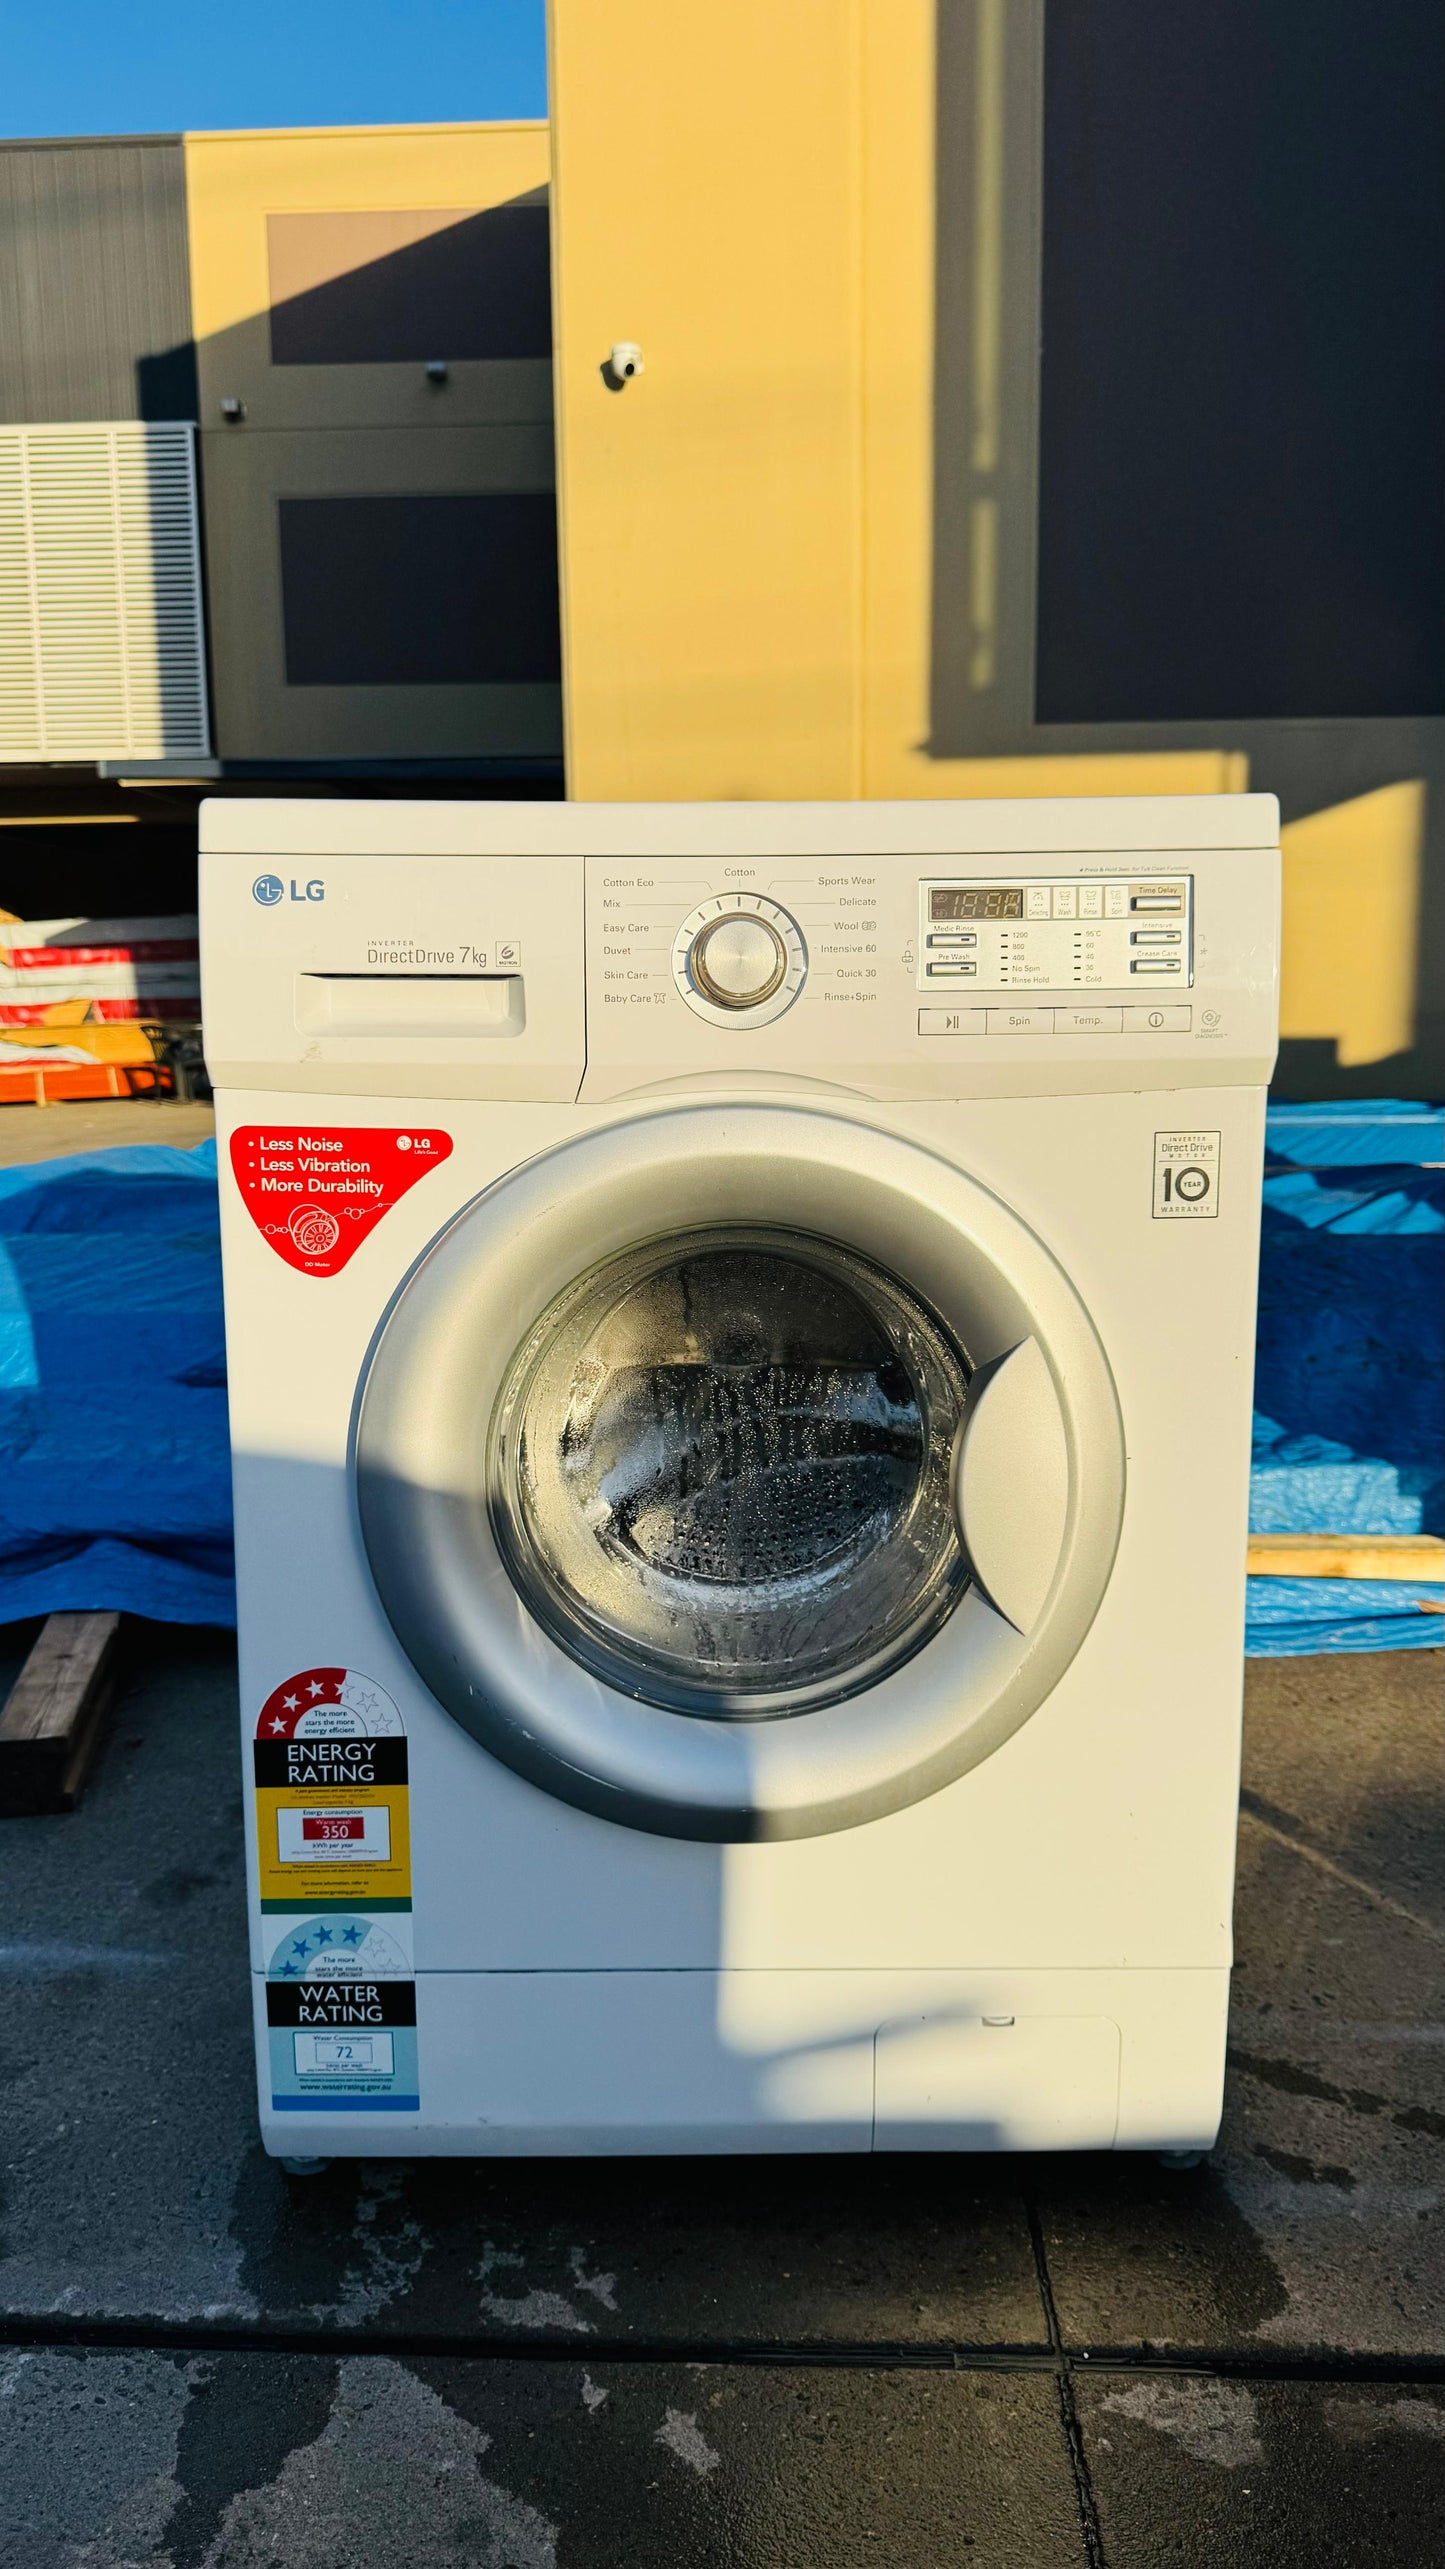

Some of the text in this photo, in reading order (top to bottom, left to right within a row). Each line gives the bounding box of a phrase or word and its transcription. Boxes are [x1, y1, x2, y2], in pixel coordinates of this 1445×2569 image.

[724, 868, 755, 877] Cotton
[603, 878, 654, 887] Cotton Eco
[818, 876, 876, 887] Sports Wear
[290, 880, 324, 901] LG
[1158, 886, 1178, 894] Delay
[603, 900, 620, 908] Mix
[839, 898, 876, 906] Delicate
[603, 924, 649, 934] Easy Care
[834, 922, 859, 931] Wool
[603, 946, 631, 955] Duvet
[821, 944, 877, 953] Intensive 60
[604, 971, 648, 980] Skin Care
[836, 969, 877, 978] Quick 30
[604, 994, 652, 1005] Baby Care
[824, 992, 877, 1002] Rinse+Spin
[1009, 1016, 1031, 1026] Spin
[1073, 1016, 1103, 1025] Temp.
[260, 1137, 343, 1152] Less Noise
[414, 1138, 430, 1148] LG
[1162, 1143, 1214, 1152] Direct Drive
[260, 1158, 370, 1173] Less Vibration
[261, 1178, 384, 1197] More Durability
[1162, 1167, 1210, 1202] 10
[287, 1743, 376, 1762] ENERGY
[288, 1764, 375, 1783] RATING
[322, 1825, 349, 1838] 350
[299, 1986, 380, 2002] WATER
[299, 2005, 382, 2022] RATING
[336, 2046, 353, 2058] 72
